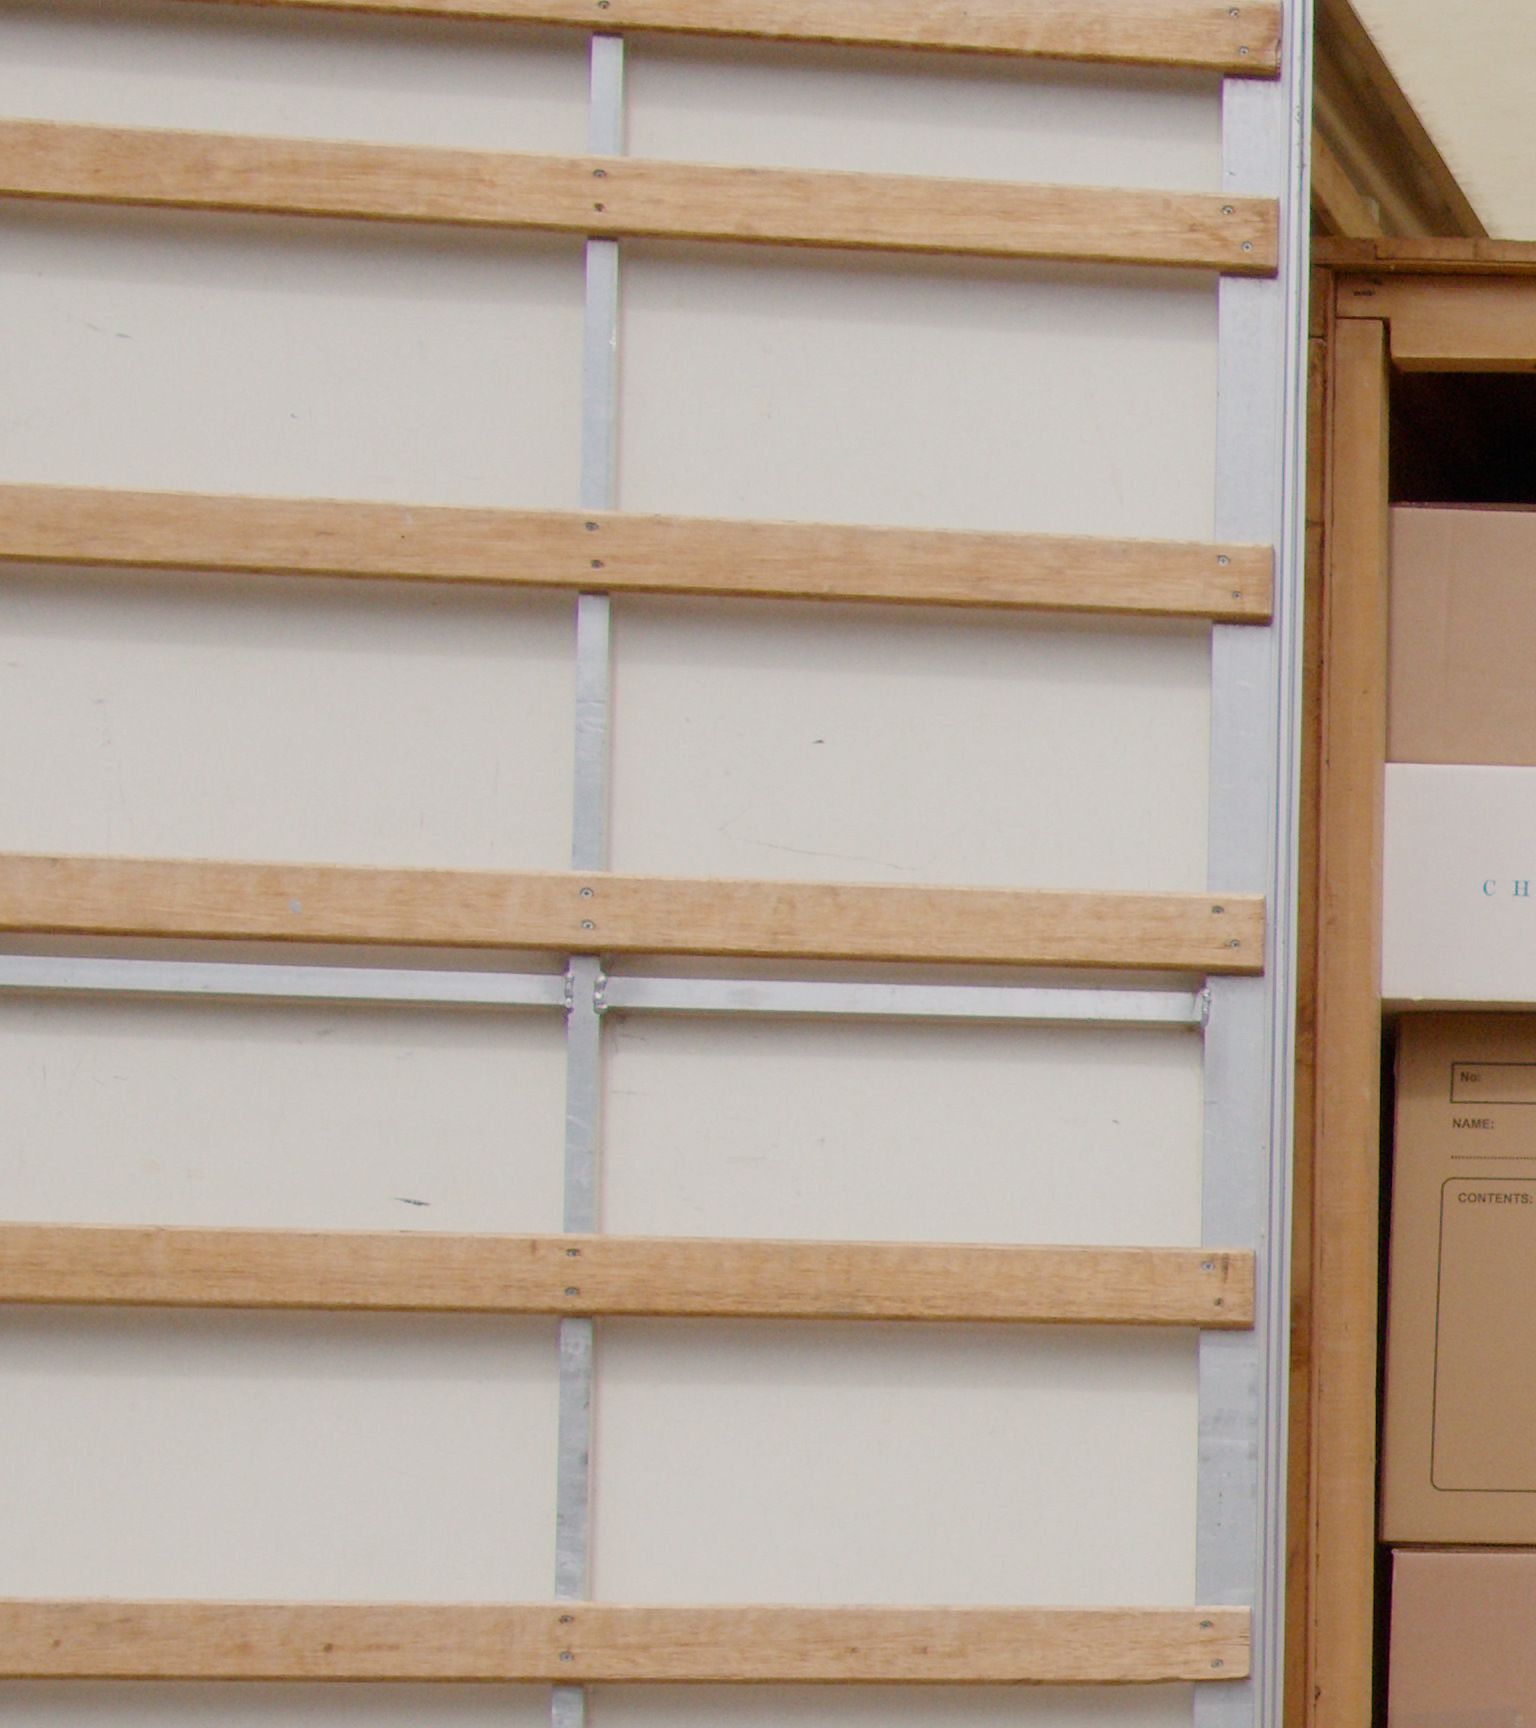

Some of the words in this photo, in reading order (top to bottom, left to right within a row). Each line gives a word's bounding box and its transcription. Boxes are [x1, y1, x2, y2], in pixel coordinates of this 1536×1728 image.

[1460, 1071, 1481, 1083] No:
[1452, 1117, 1494, 1129] NAME:
[1458, 1192, 1533, 1205] CONTENTS:
